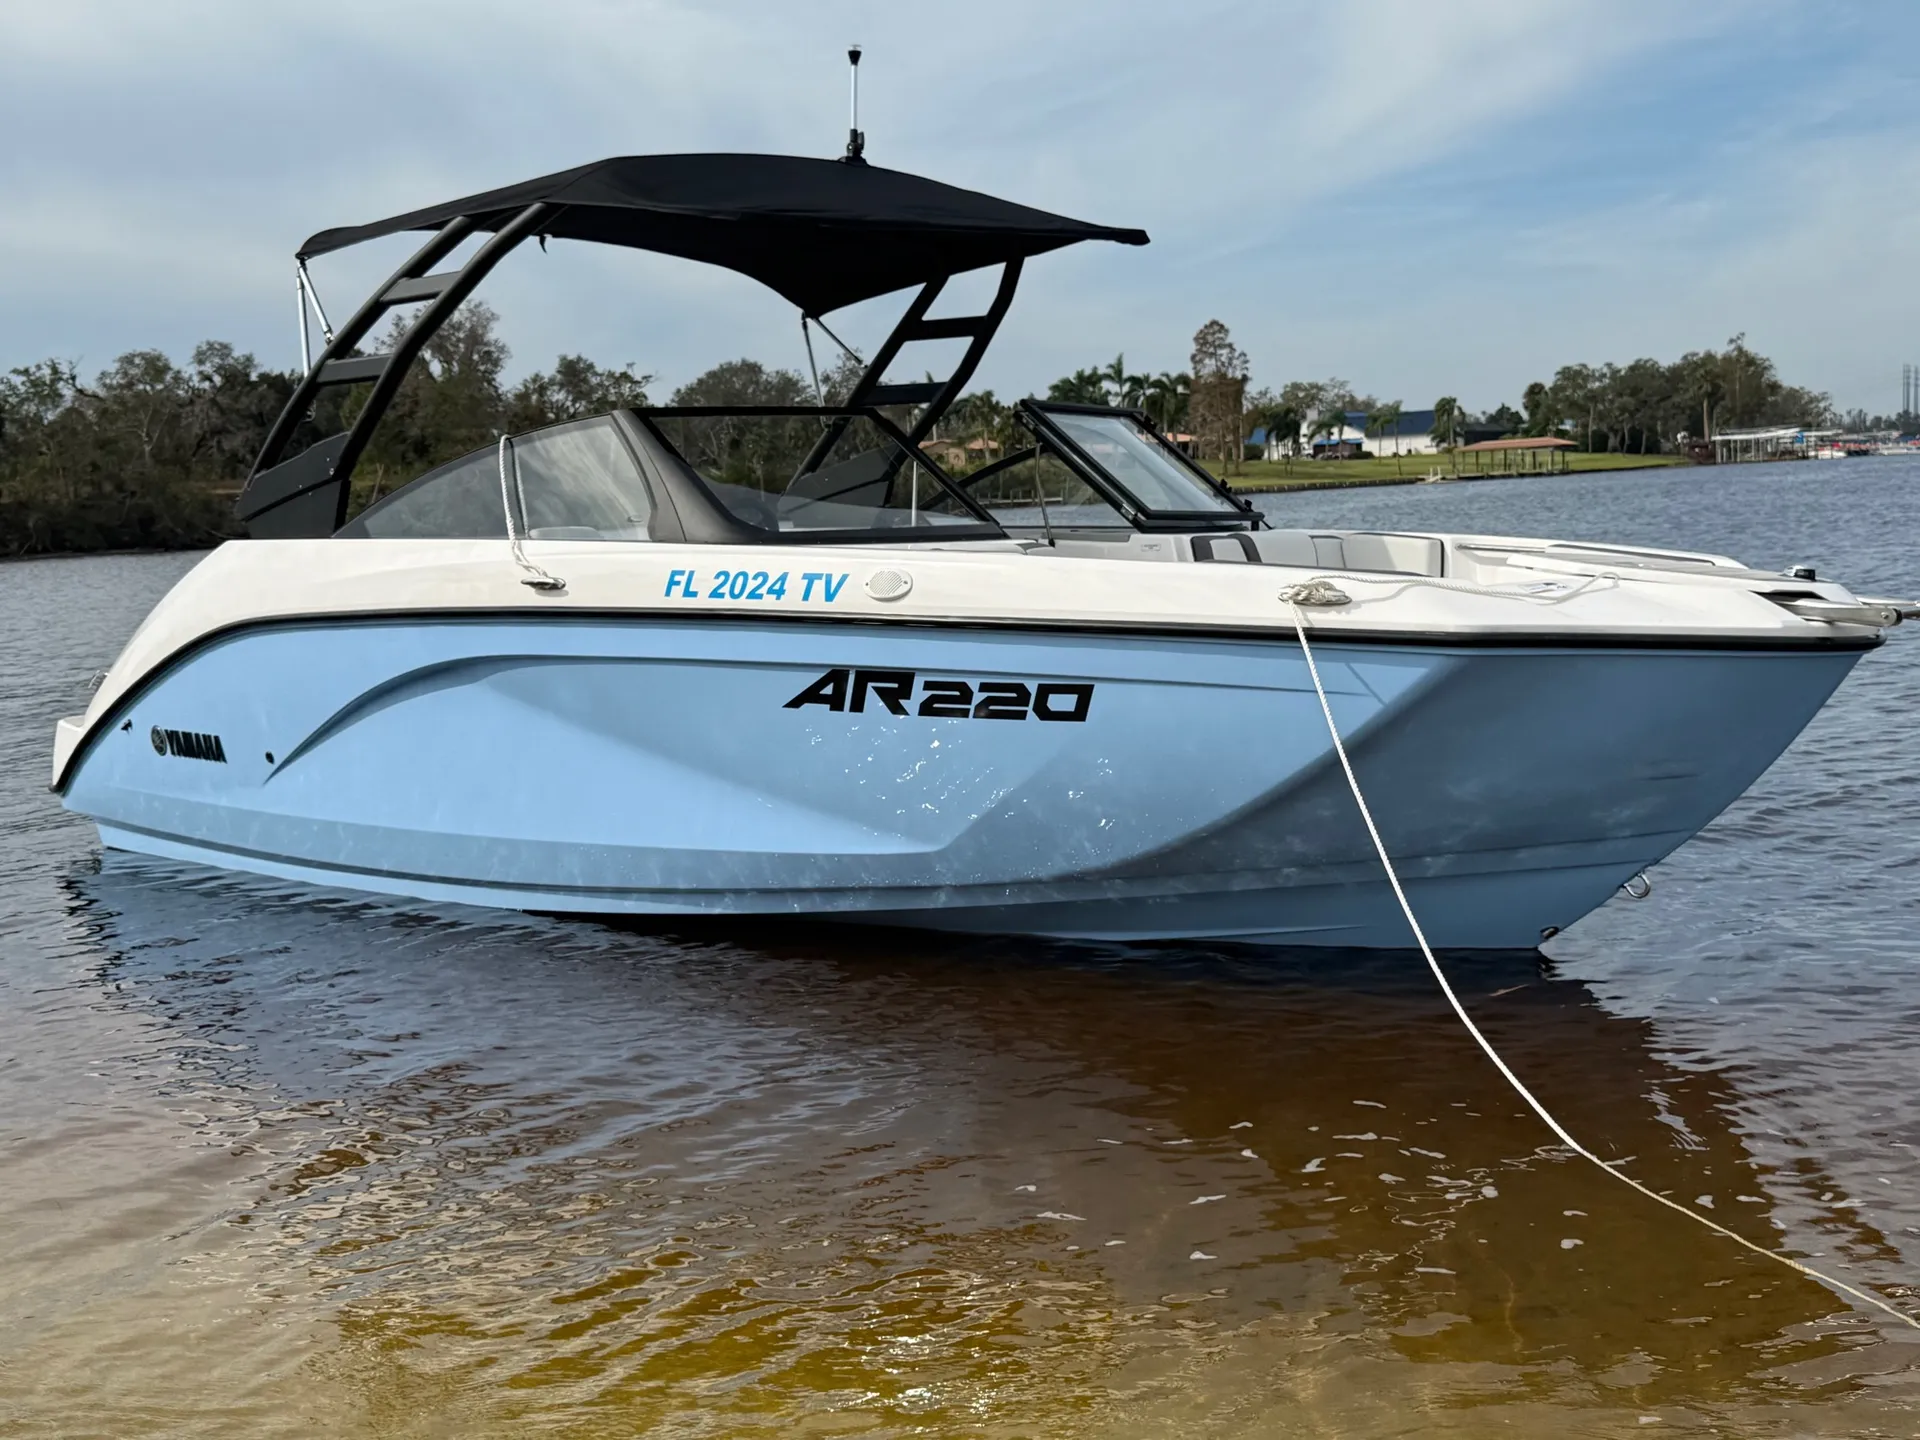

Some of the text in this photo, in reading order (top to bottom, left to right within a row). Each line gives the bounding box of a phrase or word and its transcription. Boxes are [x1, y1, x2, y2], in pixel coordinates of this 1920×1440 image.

[664, 569, 849, 602] FL 2024 TV
[782, 669, 1095, 722] AR220
[164, 729, 227, 763] YAMAHA
